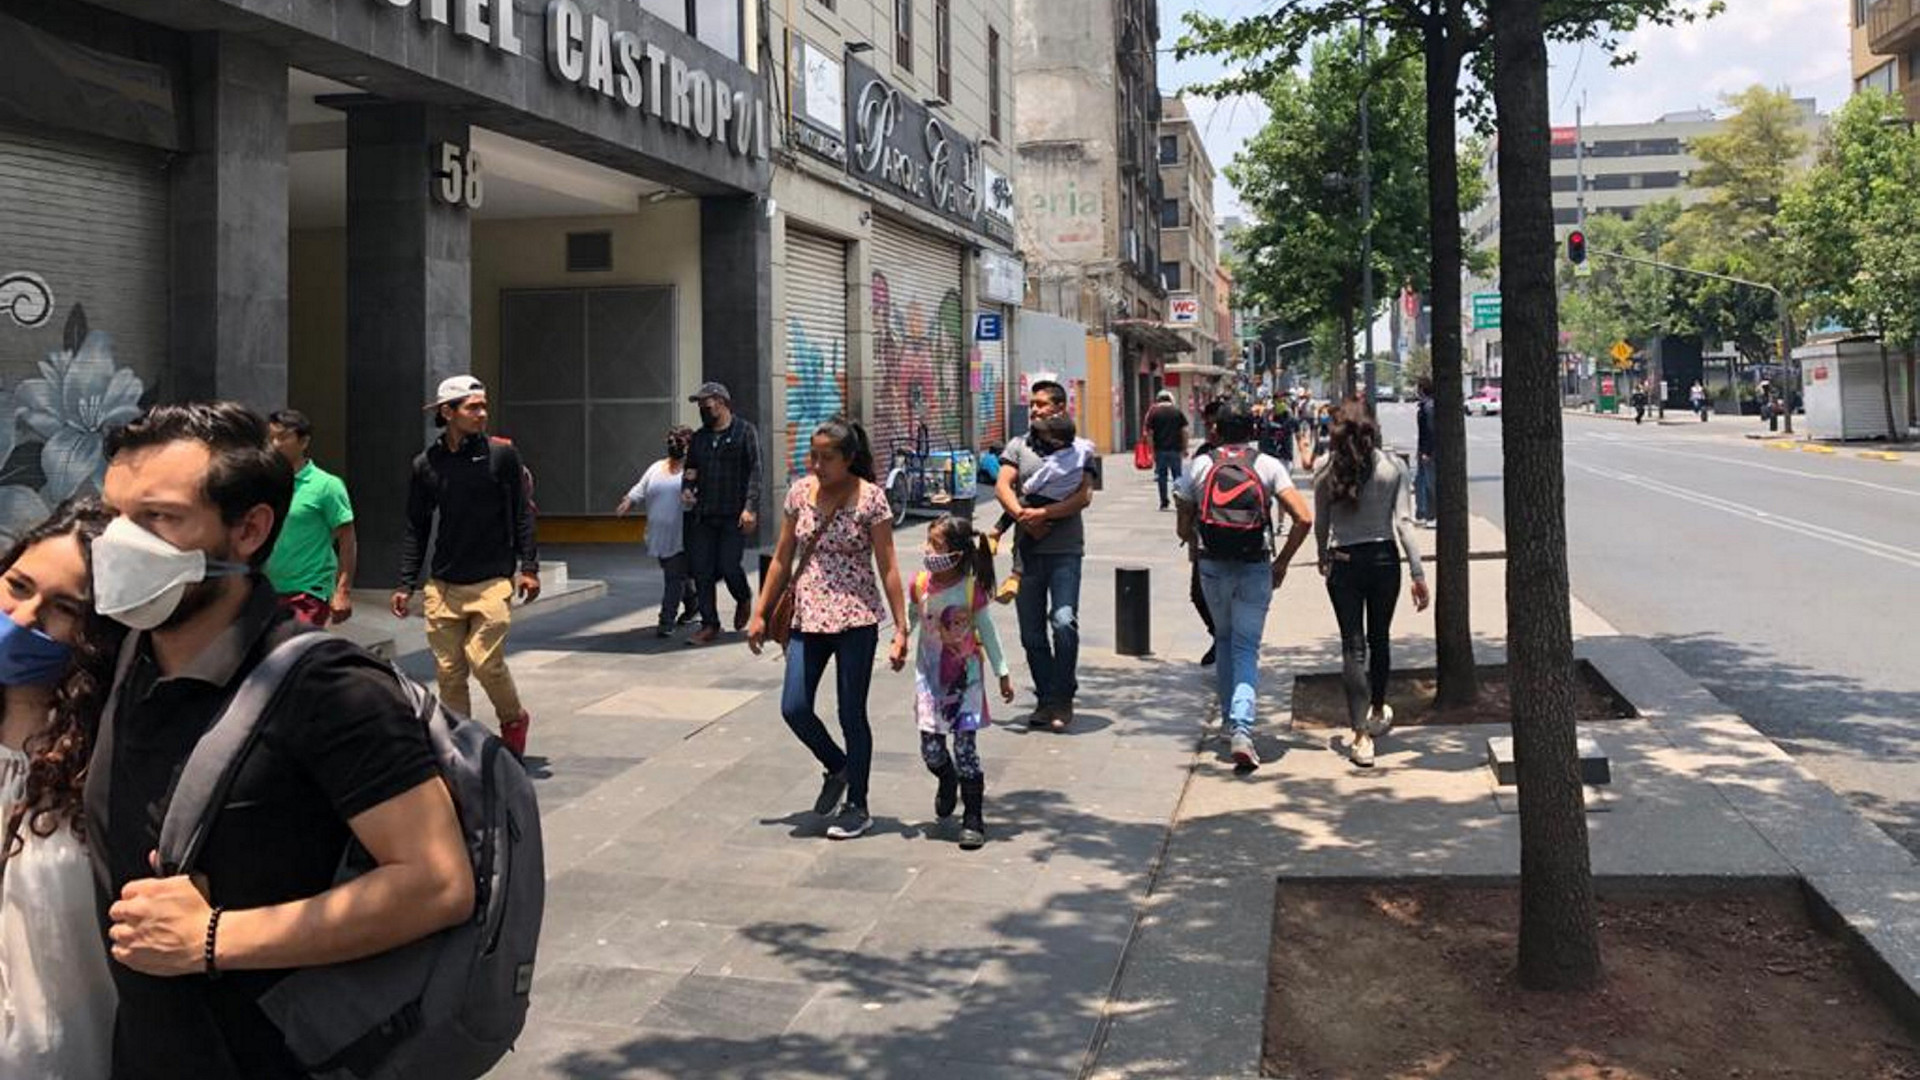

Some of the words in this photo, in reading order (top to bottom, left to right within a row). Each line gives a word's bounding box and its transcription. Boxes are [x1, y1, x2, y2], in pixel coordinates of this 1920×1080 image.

[549, 0, 769, 160] CASTROPOL
[442, 141, 483, 208] 58
[980, 318, 996, 337] E
[1172, 301, 1196, 312] WC
